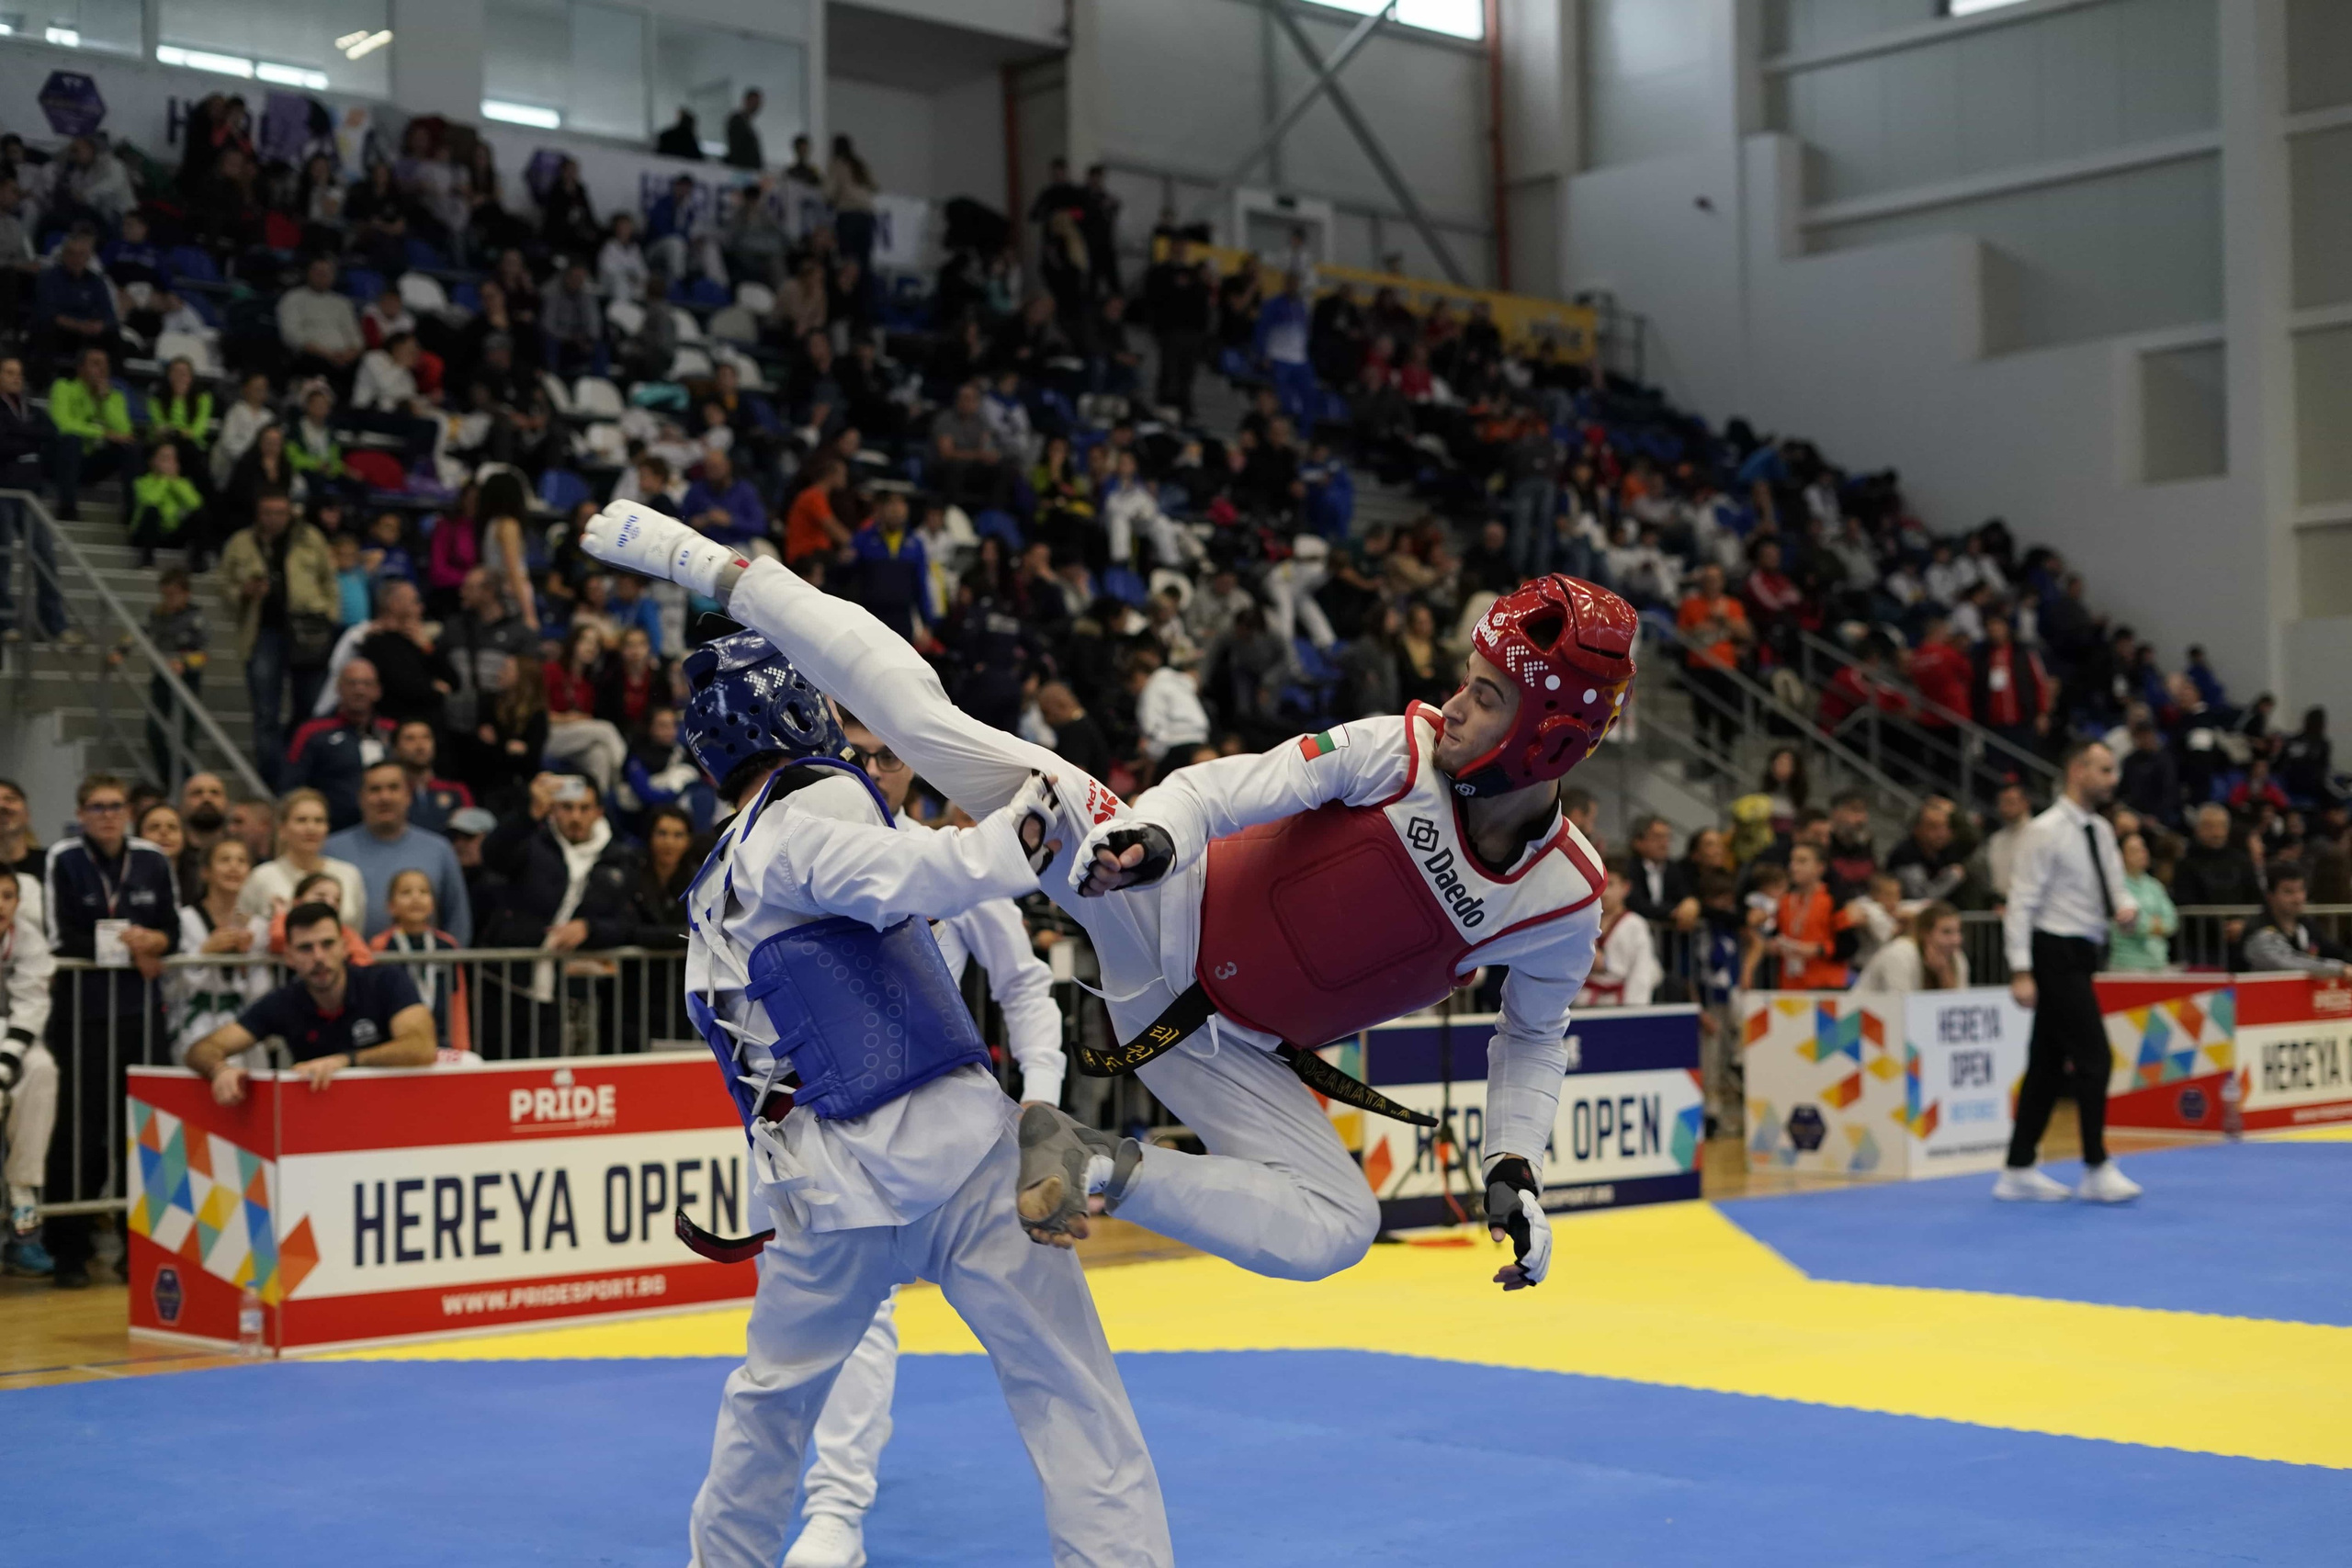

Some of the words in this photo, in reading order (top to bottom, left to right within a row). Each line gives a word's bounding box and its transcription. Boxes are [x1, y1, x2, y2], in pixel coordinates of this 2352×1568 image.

[1423, 847, 1485, 928] Daedo
[1215, 961, 1238, 980] 3
[509, 1084, 616, 1122] PRIDE
[1573, 1094, 1661, 1160] OPEN
[354, 1168, 579, 1267] HEREYA
[605, 1155, 740, 1245] OPEN
[441, 1274, 667, 1316] WWW.PRIDESPORT.BG
